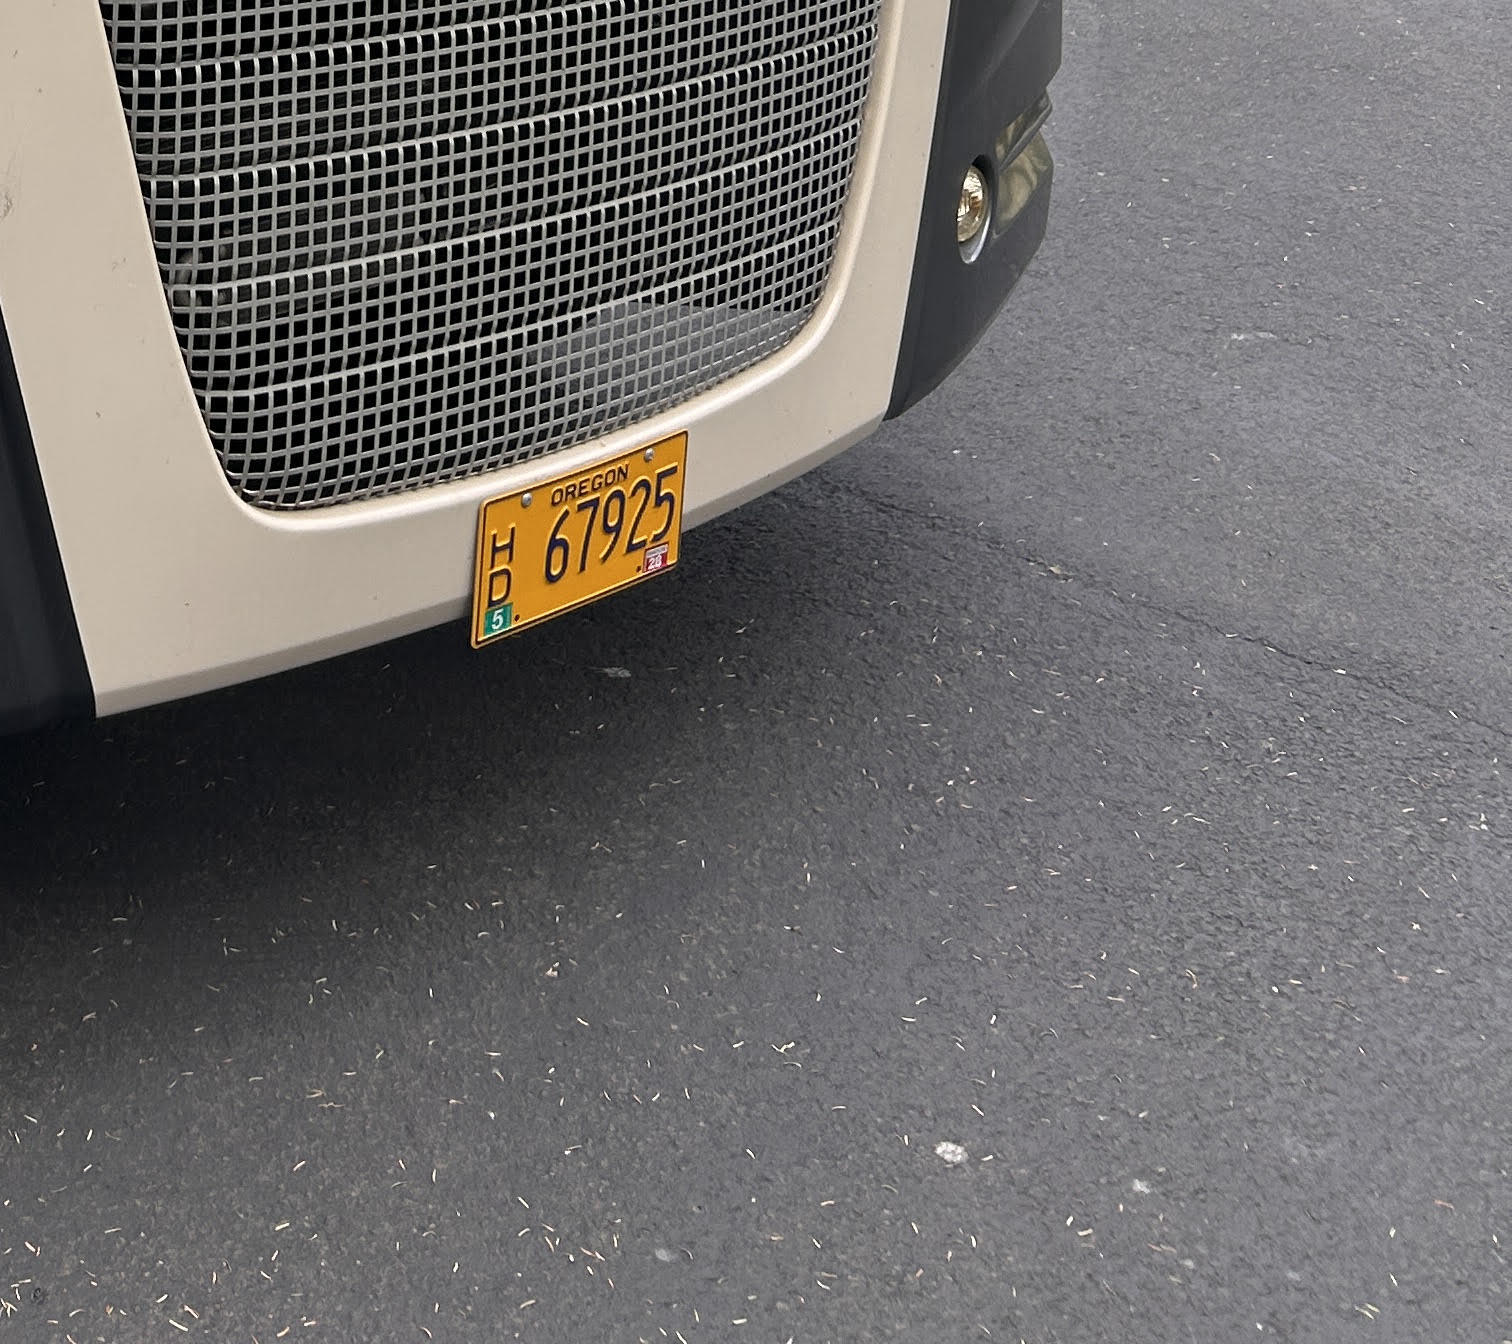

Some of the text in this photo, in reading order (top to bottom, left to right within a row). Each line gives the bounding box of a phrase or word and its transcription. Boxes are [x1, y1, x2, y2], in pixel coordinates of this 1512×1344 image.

[550, 463, 630, 507] OREGON
[544, 462, 678, 584] 67925
[491, 609, 504, 630] 5
